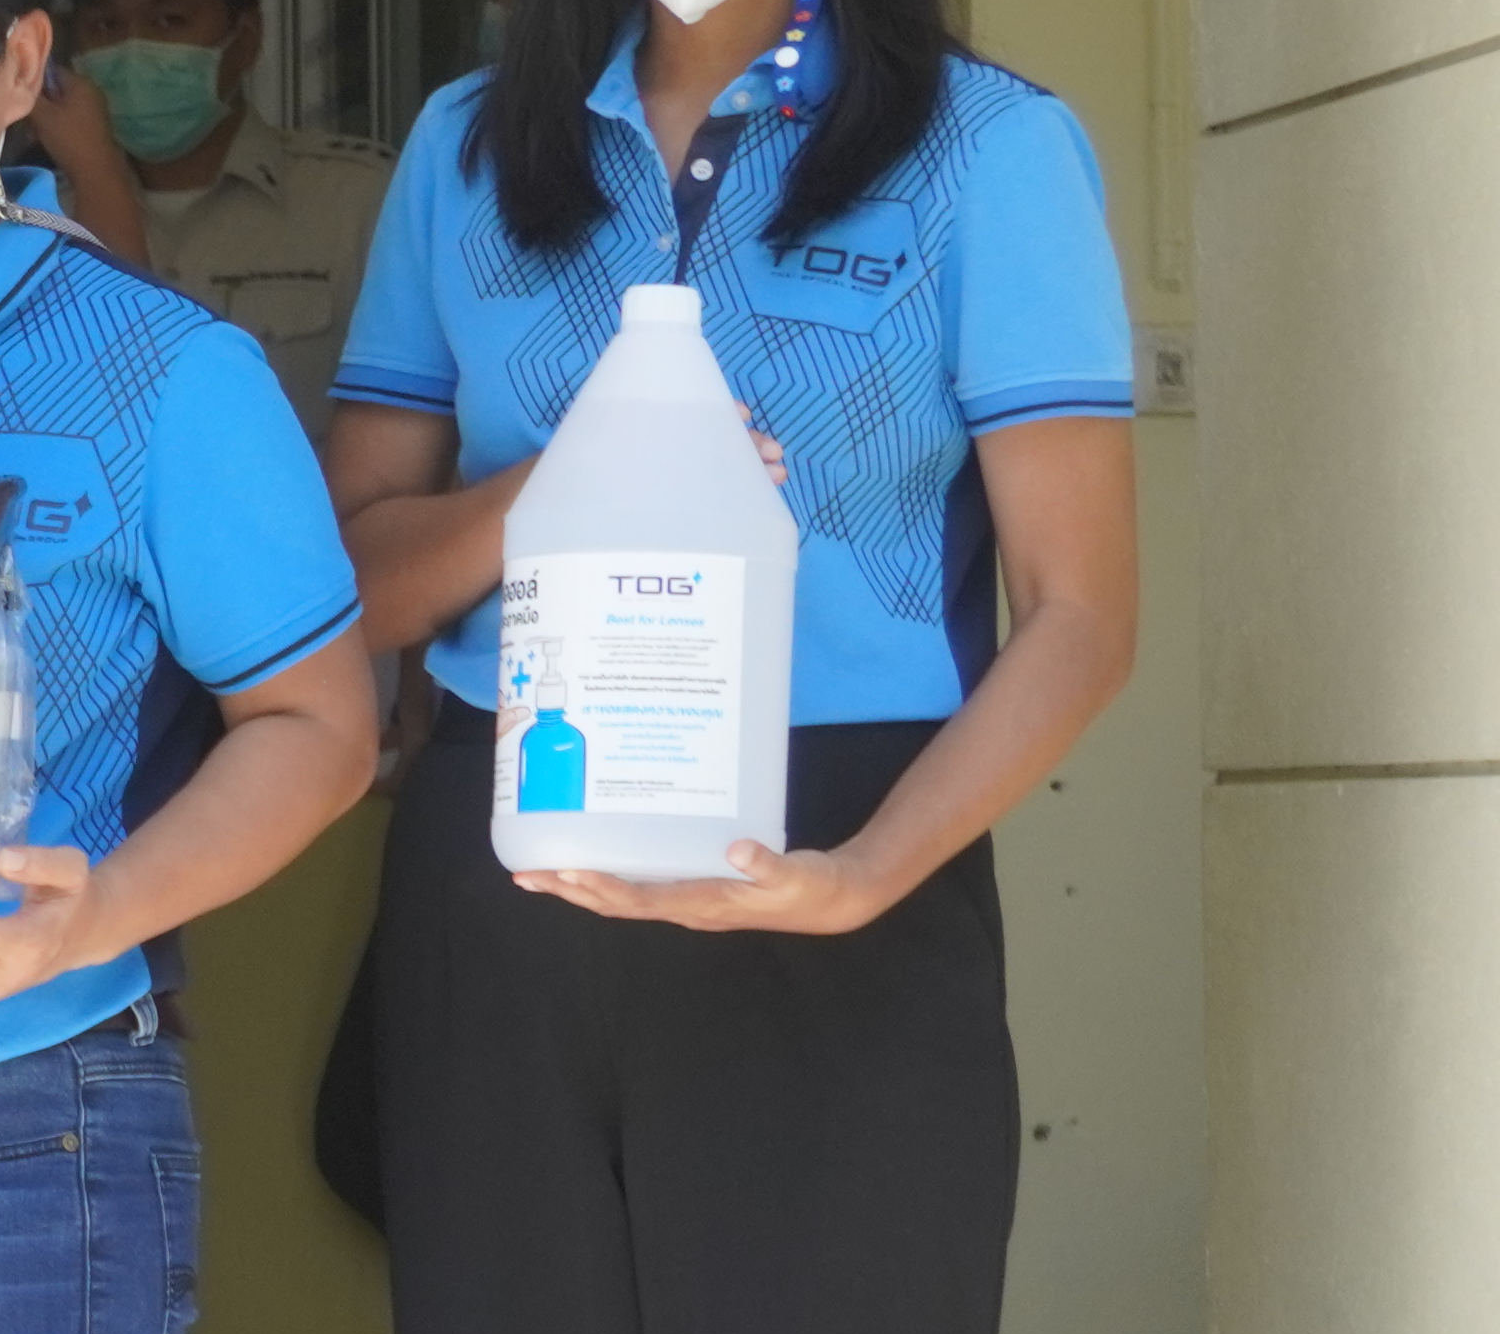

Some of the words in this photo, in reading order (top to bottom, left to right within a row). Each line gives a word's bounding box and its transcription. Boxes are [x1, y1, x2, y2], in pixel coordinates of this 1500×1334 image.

[767, 244, 891, 287] TOG
[608, 575, 693, 595] TOG
[606, 614, 637, 626] Best
[639, 614, 656, 626] for
[660, 614, 705, 628] Lenses
